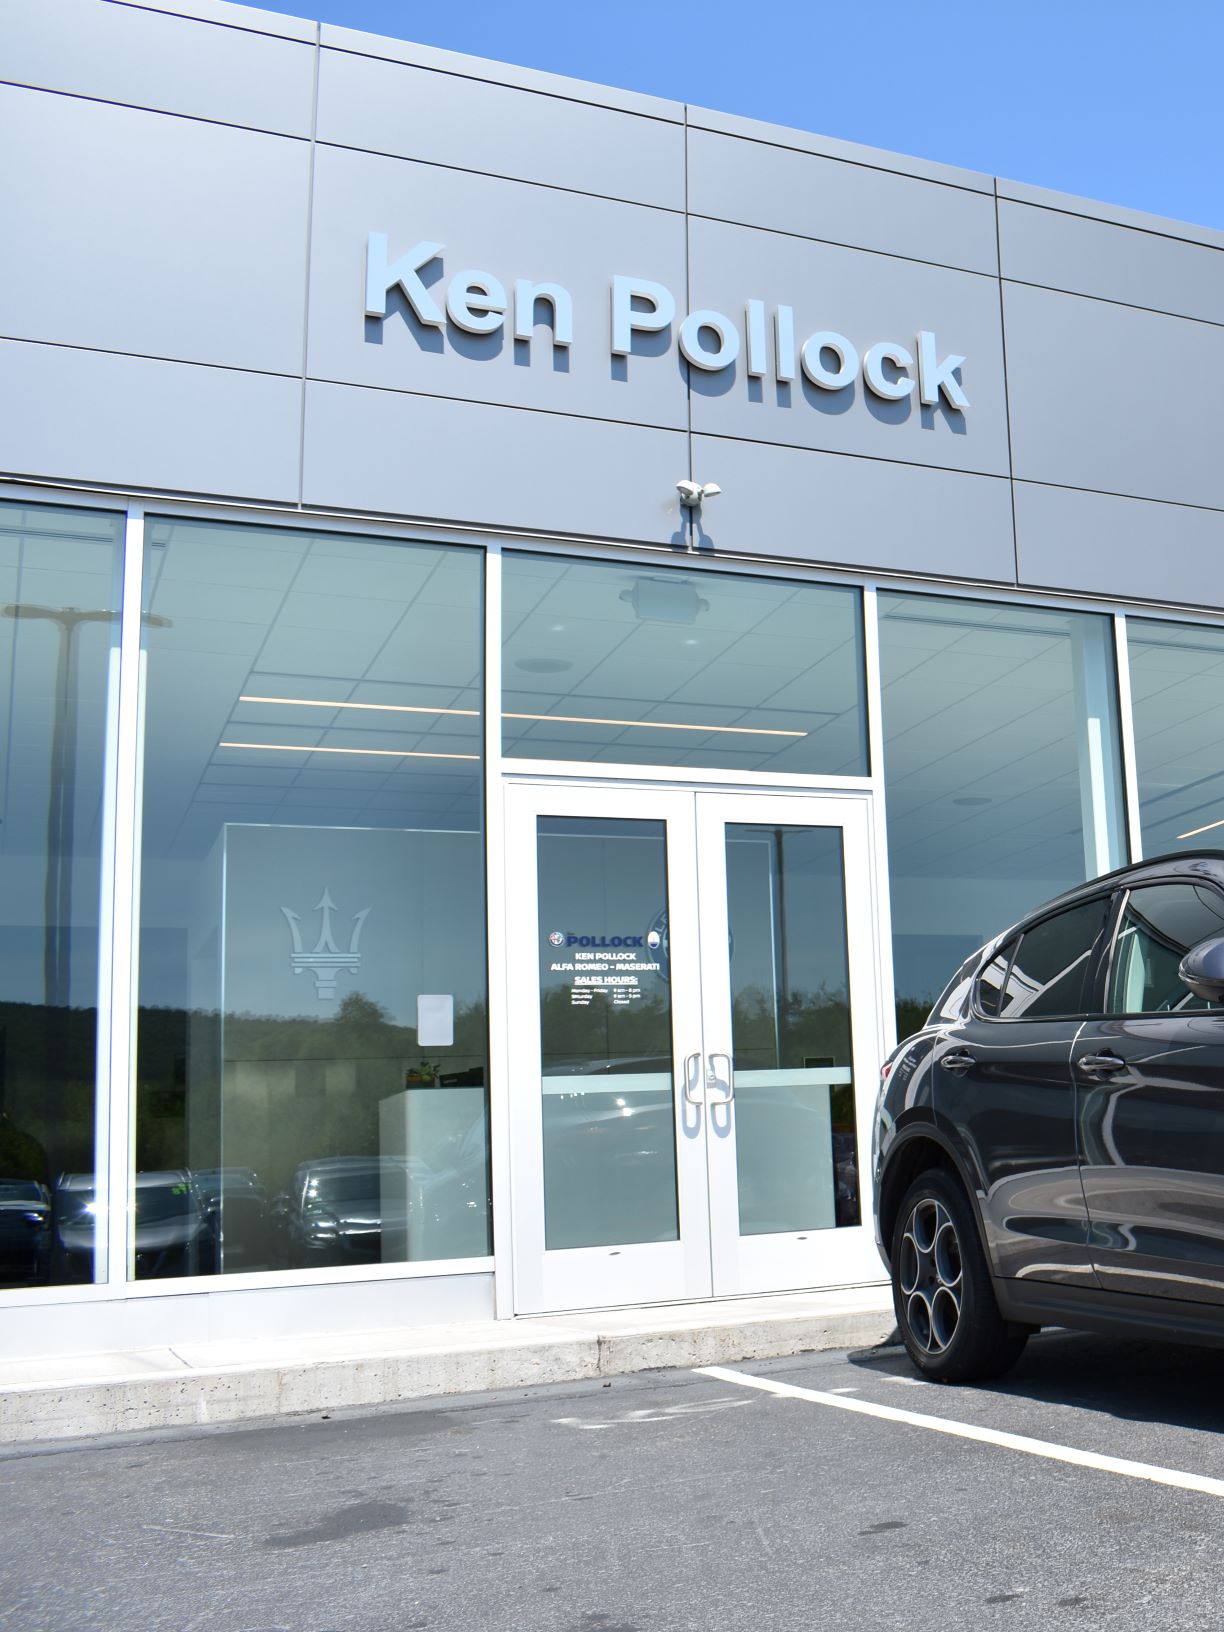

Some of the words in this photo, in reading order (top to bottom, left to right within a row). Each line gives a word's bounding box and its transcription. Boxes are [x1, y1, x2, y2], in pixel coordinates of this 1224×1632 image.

[364, 231, 574, 347] Ken
[611, 274, 971, 411] Pollock
[567, 936, 644, 948] POLLOCK
[574, 976, 603, 985] SALES
[604, 976, 638, 985] HOURS:
